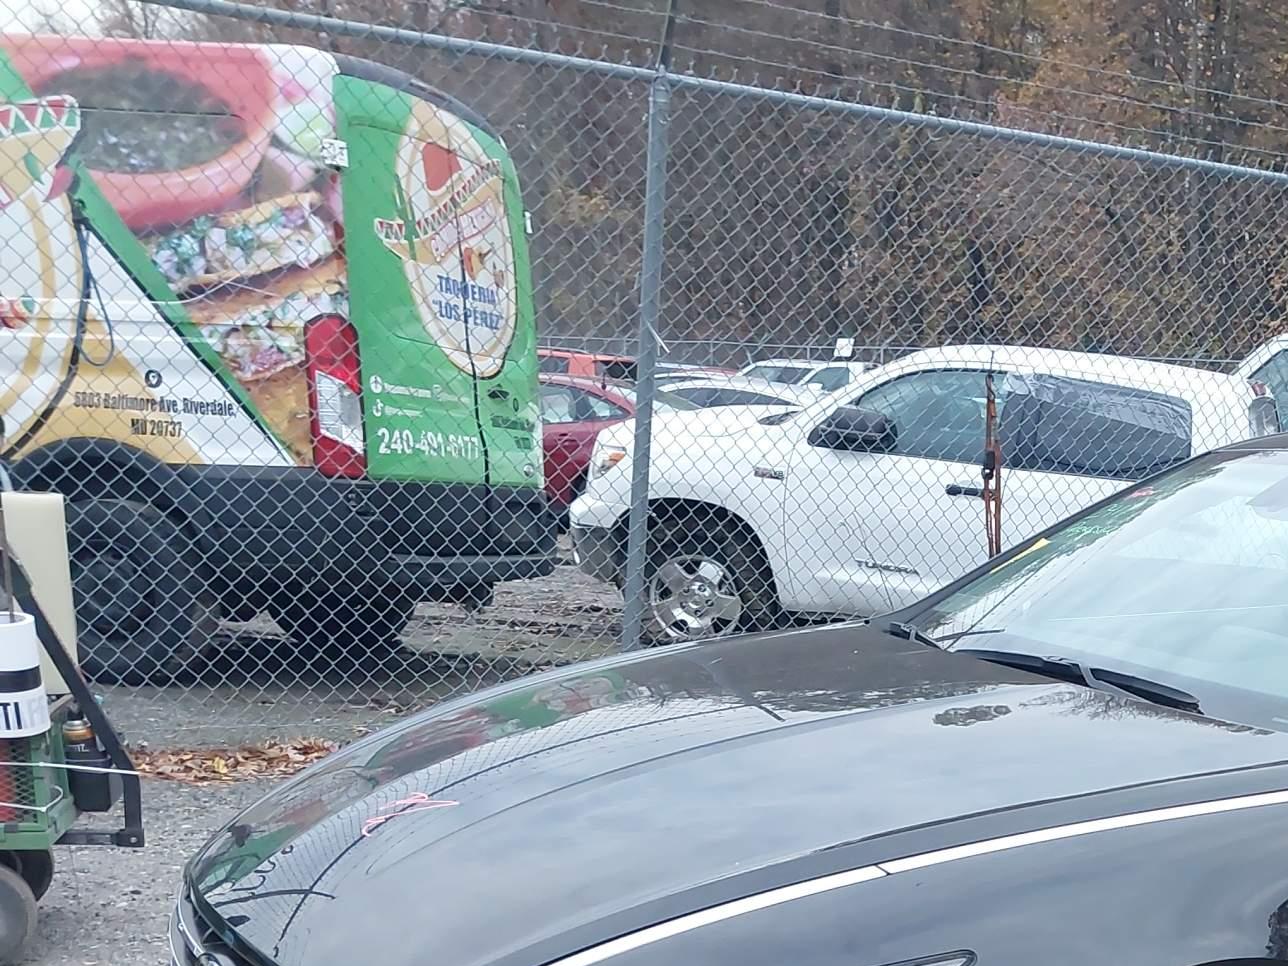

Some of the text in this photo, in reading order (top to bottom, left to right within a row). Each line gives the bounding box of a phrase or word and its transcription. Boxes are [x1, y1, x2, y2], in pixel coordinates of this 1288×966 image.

[103, 393, 158, 413] Baltimore
[130, 418, 183, 438] MD 20737
